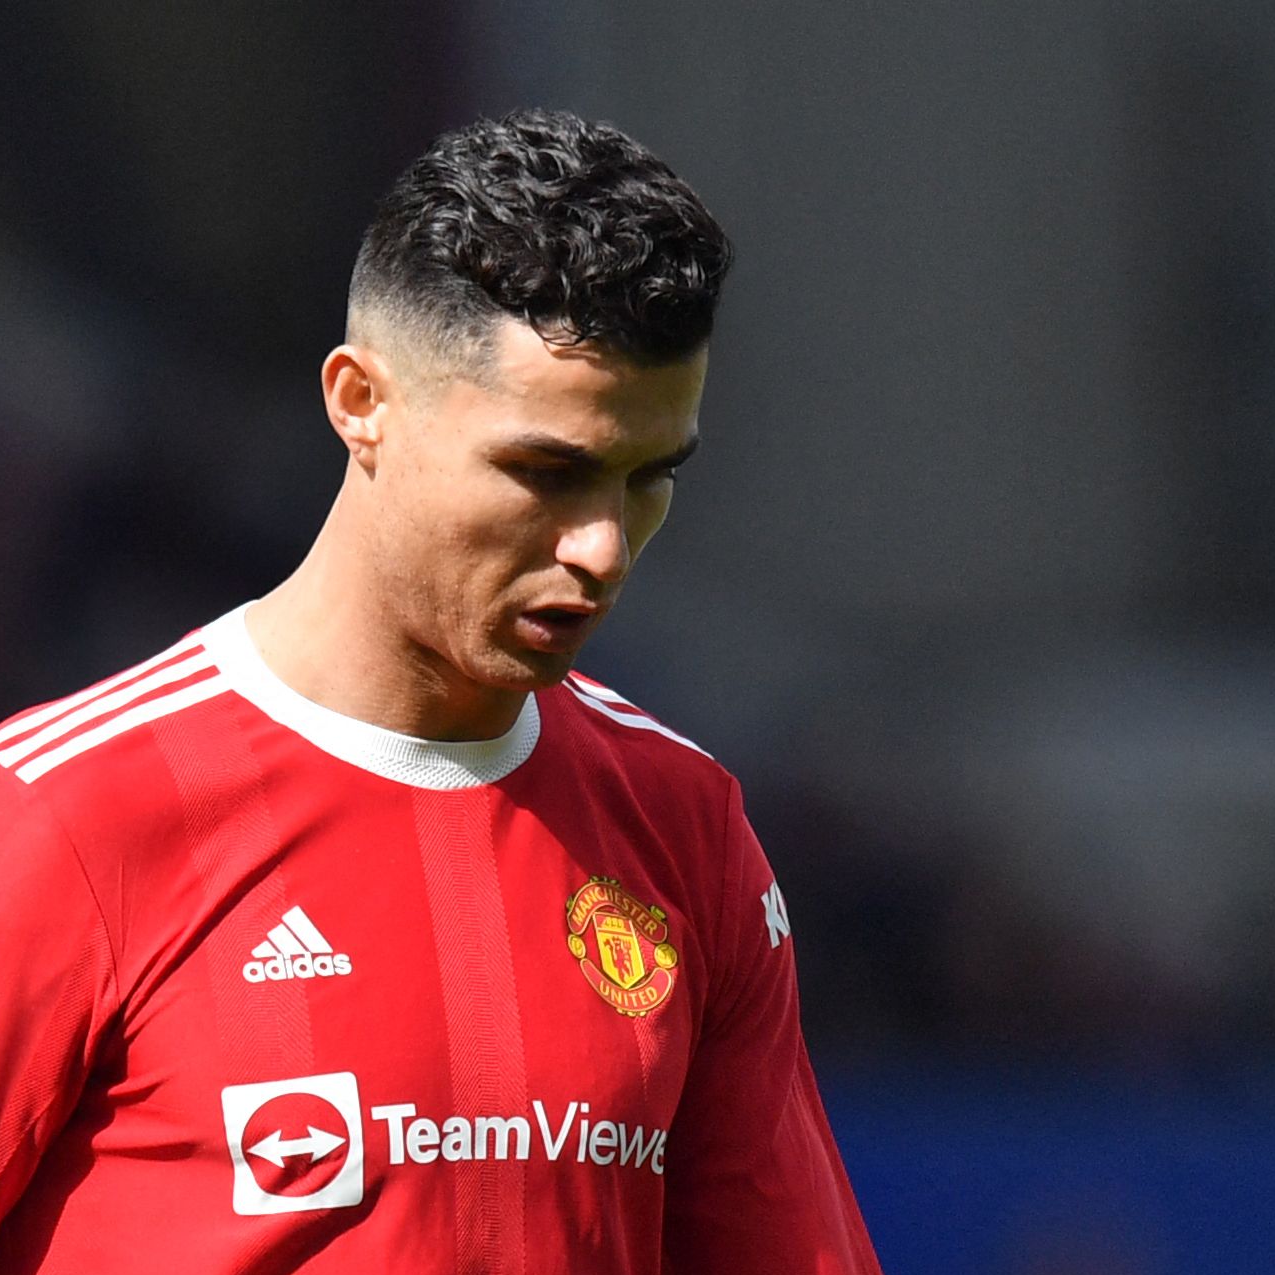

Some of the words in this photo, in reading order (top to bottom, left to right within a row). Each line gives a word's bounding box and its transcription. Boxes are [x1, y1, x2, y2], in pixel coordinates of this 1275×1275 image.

[572, 886, 658, 936] MANCHESTER
[242, 952, 352, 983] adidas
[599, 980, 658, 1007] UNITED
[370, 1099, 666, 1175] TeamViewe
